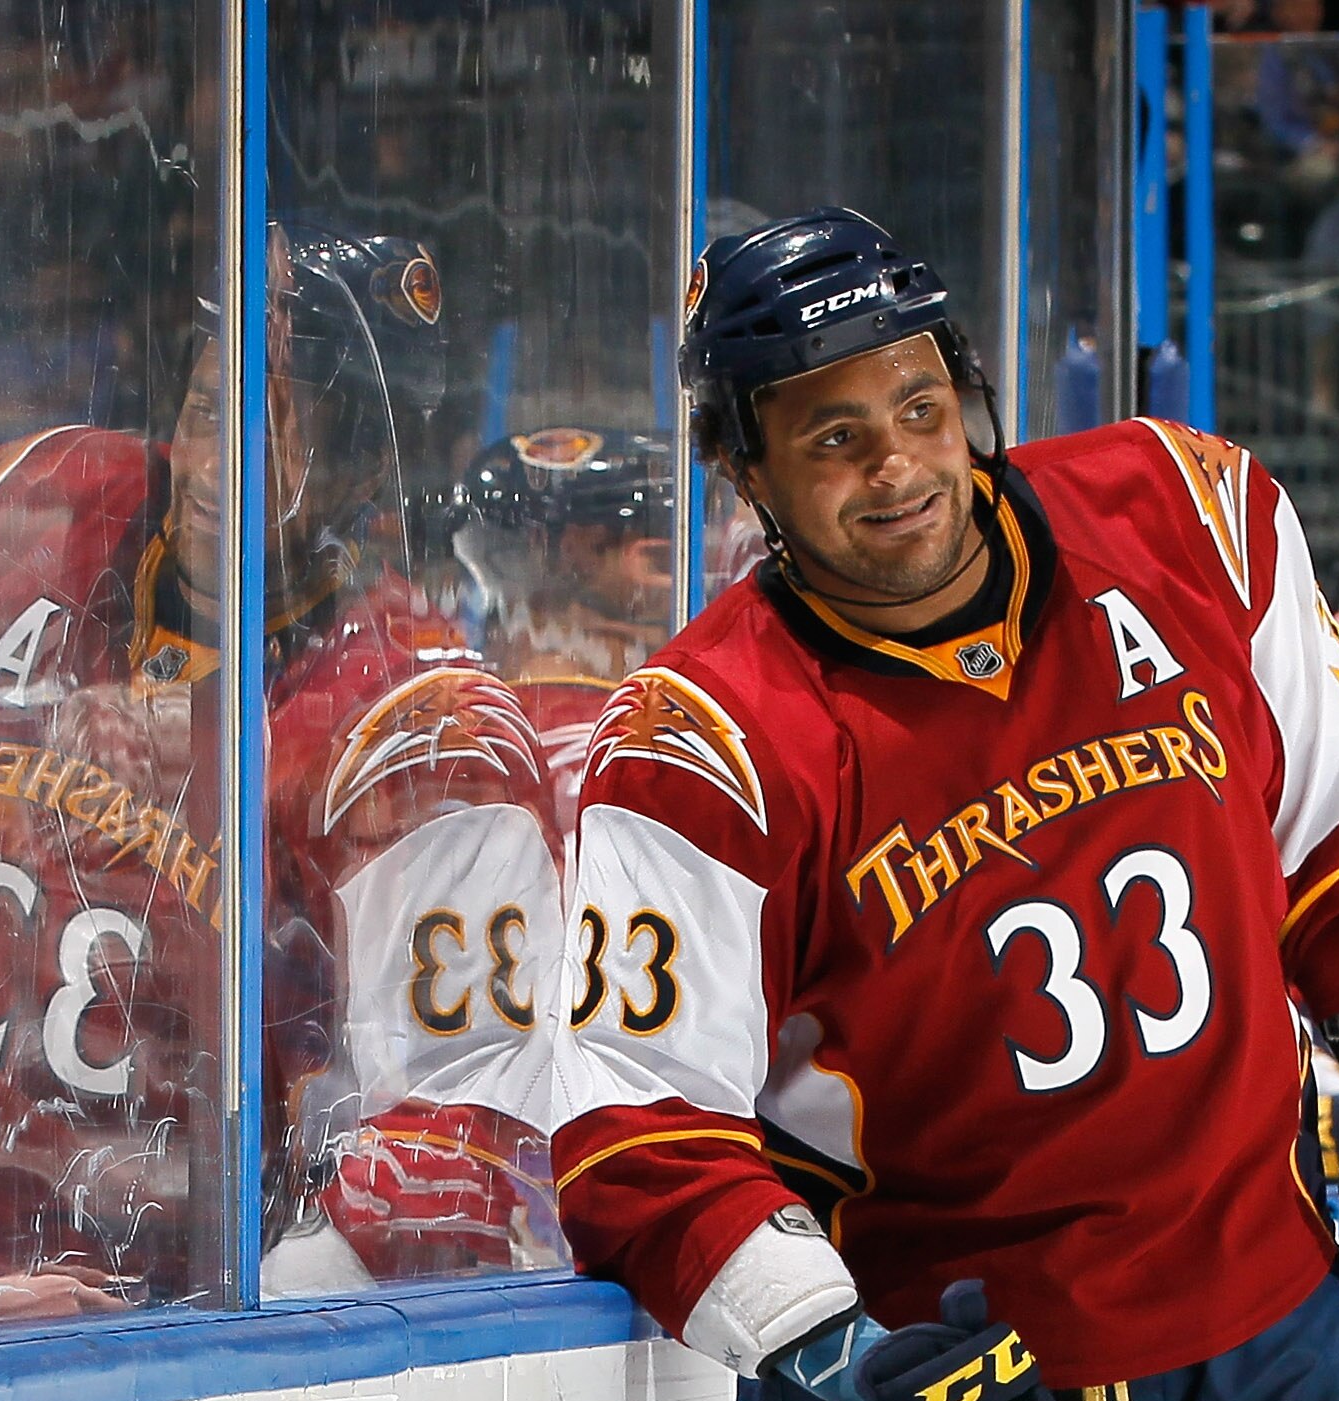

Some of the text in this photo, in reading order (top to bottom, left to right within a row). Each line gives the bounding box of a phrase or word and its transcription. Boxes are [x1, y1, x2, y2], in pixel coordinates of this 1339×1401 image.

[800, 282, 878, 322] CCM
[1089, 588, 1185, 701] A
[841, 689, 1229, 954] THRASHERS
[569, 903, 680, 1037] 33
[983, 843, 1213, 1092] 33
